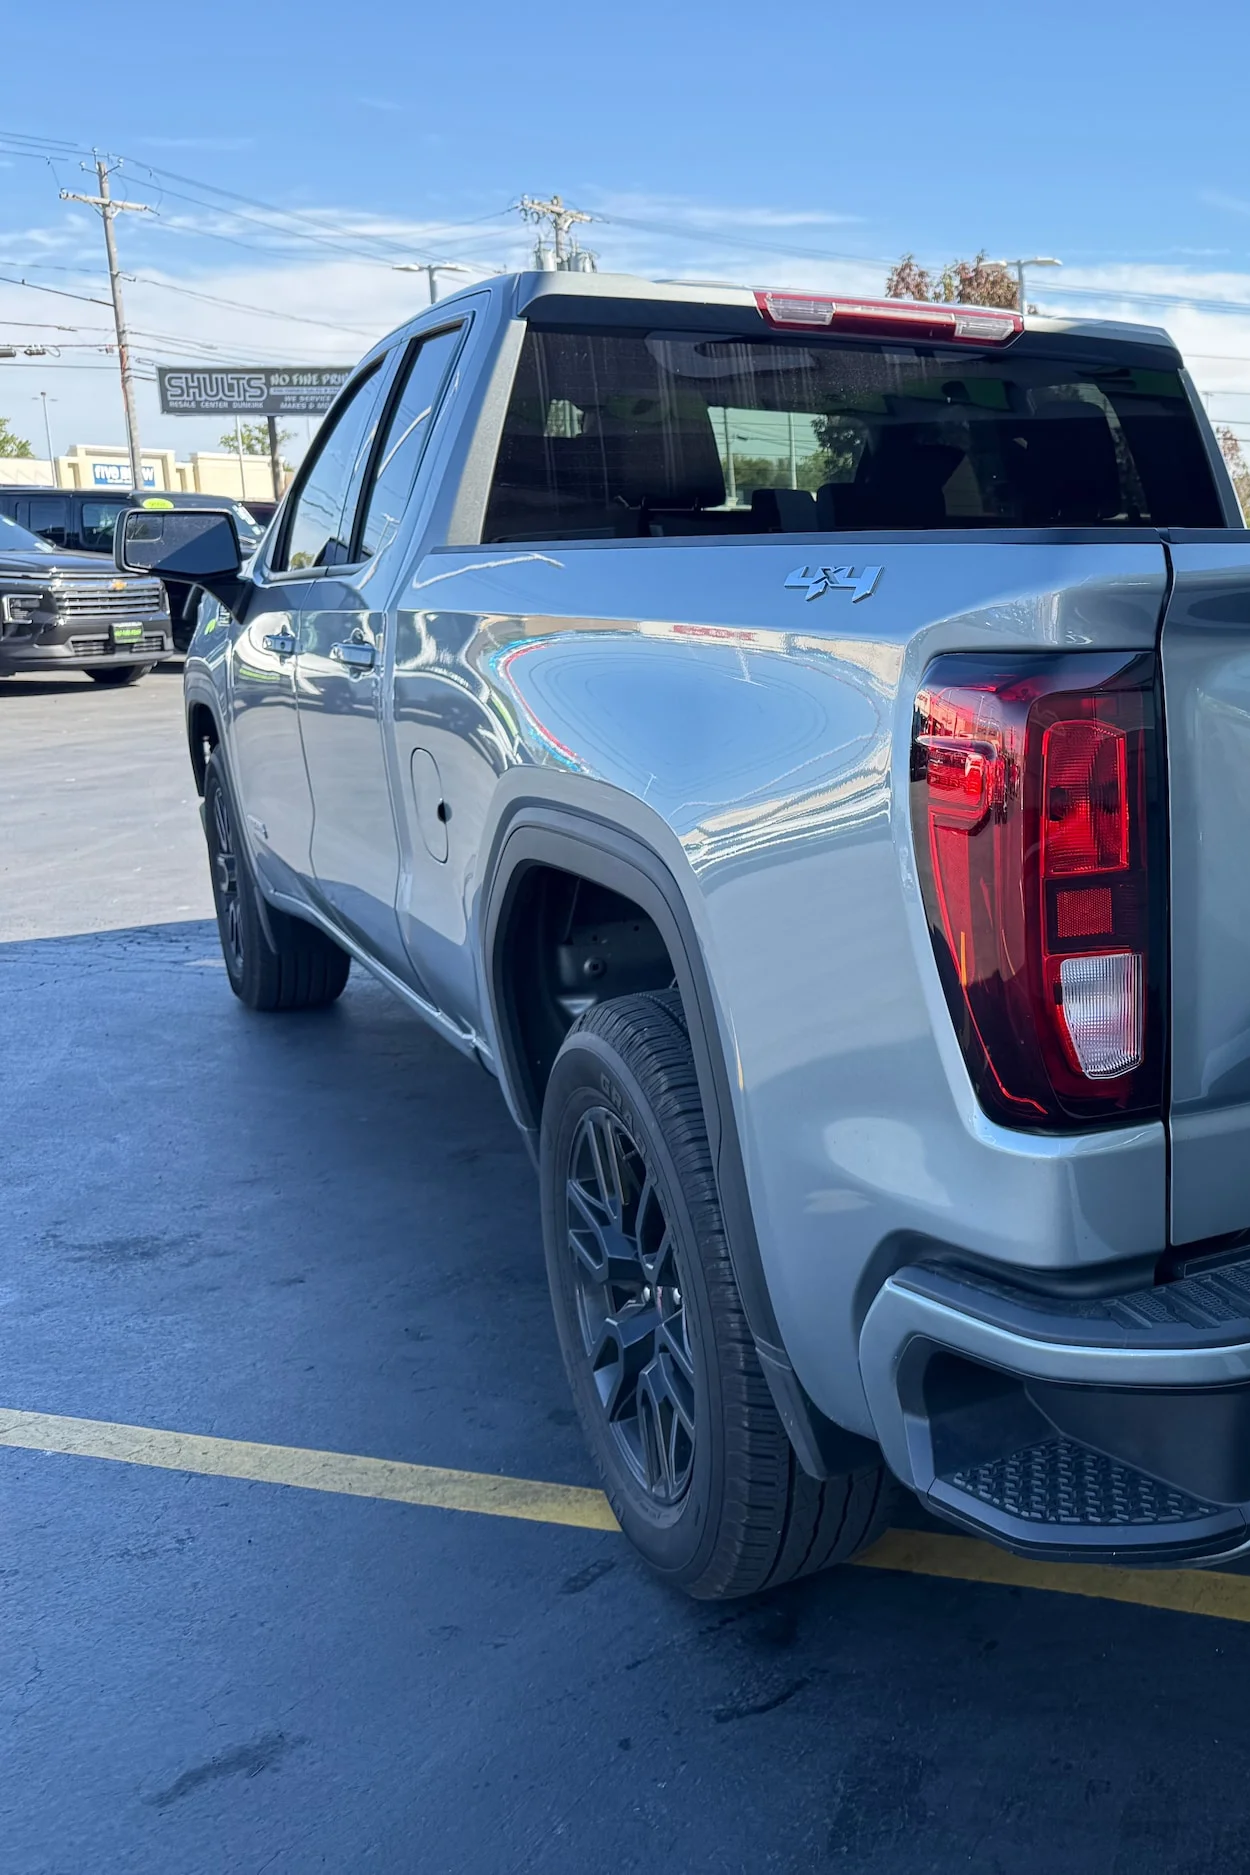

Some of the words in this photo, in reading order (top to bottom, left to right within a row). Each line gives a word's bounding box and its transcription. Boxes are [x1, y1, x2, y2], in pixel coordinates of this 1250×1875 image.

[270, 373, 290, 386] NO
[291, 372, 321, 386] FINE
[165, 373, 267, 401] SHULTS
[200, 401, 229, 409] CENTER
